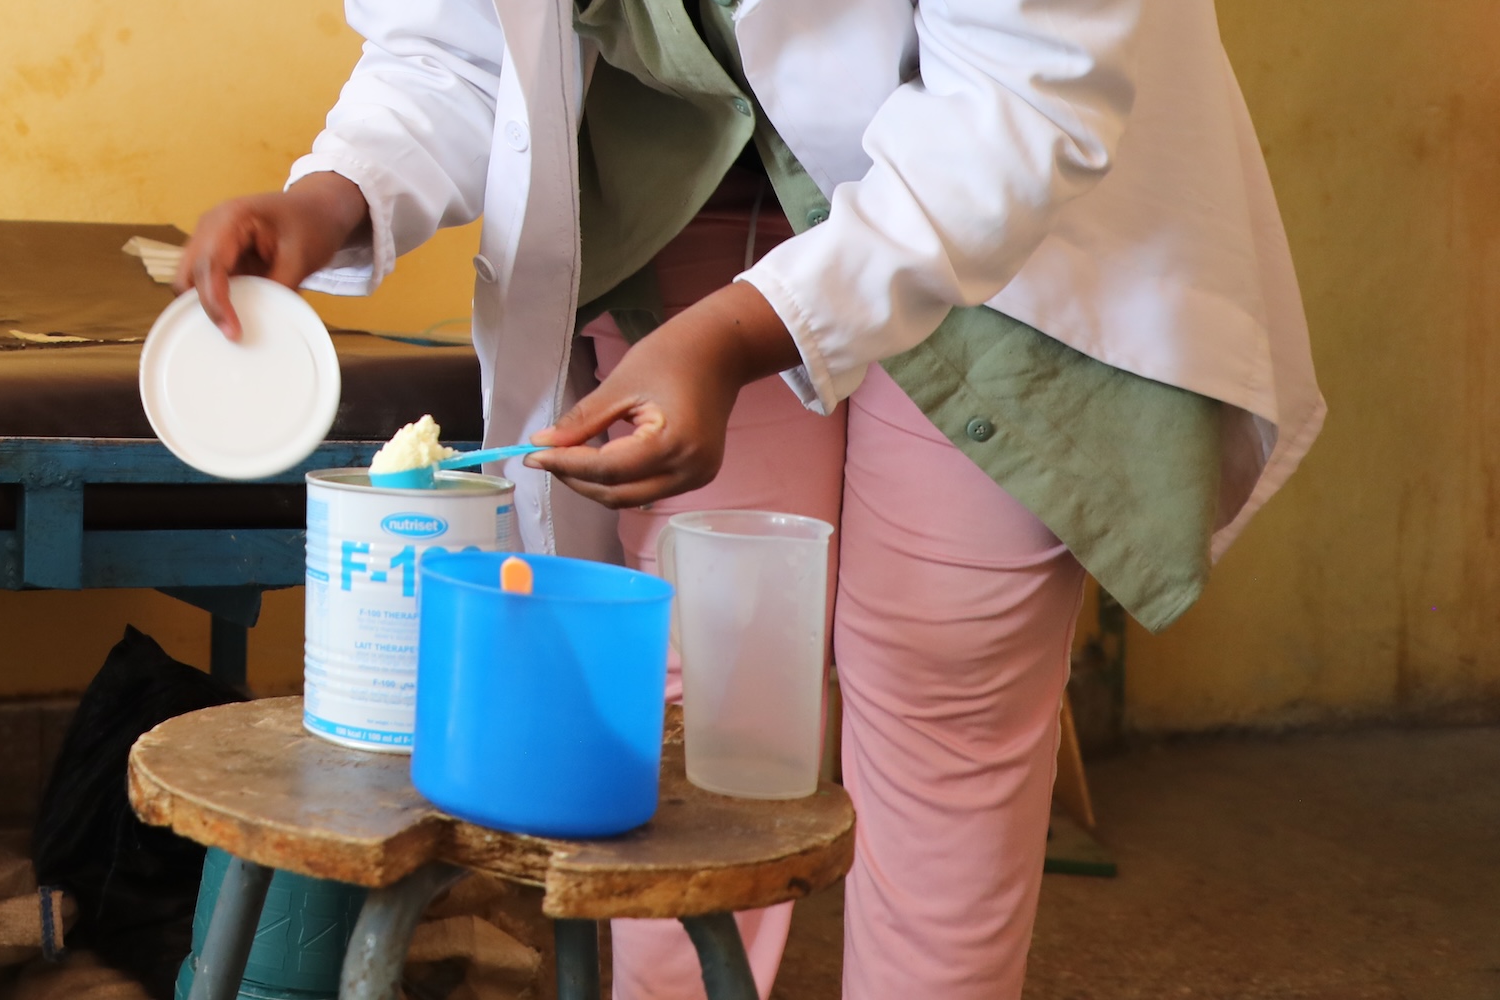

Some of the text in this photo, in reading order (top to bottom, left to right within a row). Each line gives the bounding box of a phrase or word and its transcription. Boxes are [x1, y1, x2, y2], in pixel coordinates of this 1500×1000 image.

[388, 519, 439, 532] nutriset
[341, 540, 482, 597] F-1
[359, 608, 381, 618] F-100
[355, 641, 372, 650] LAIT
[368, 732, 382, 742] 100
